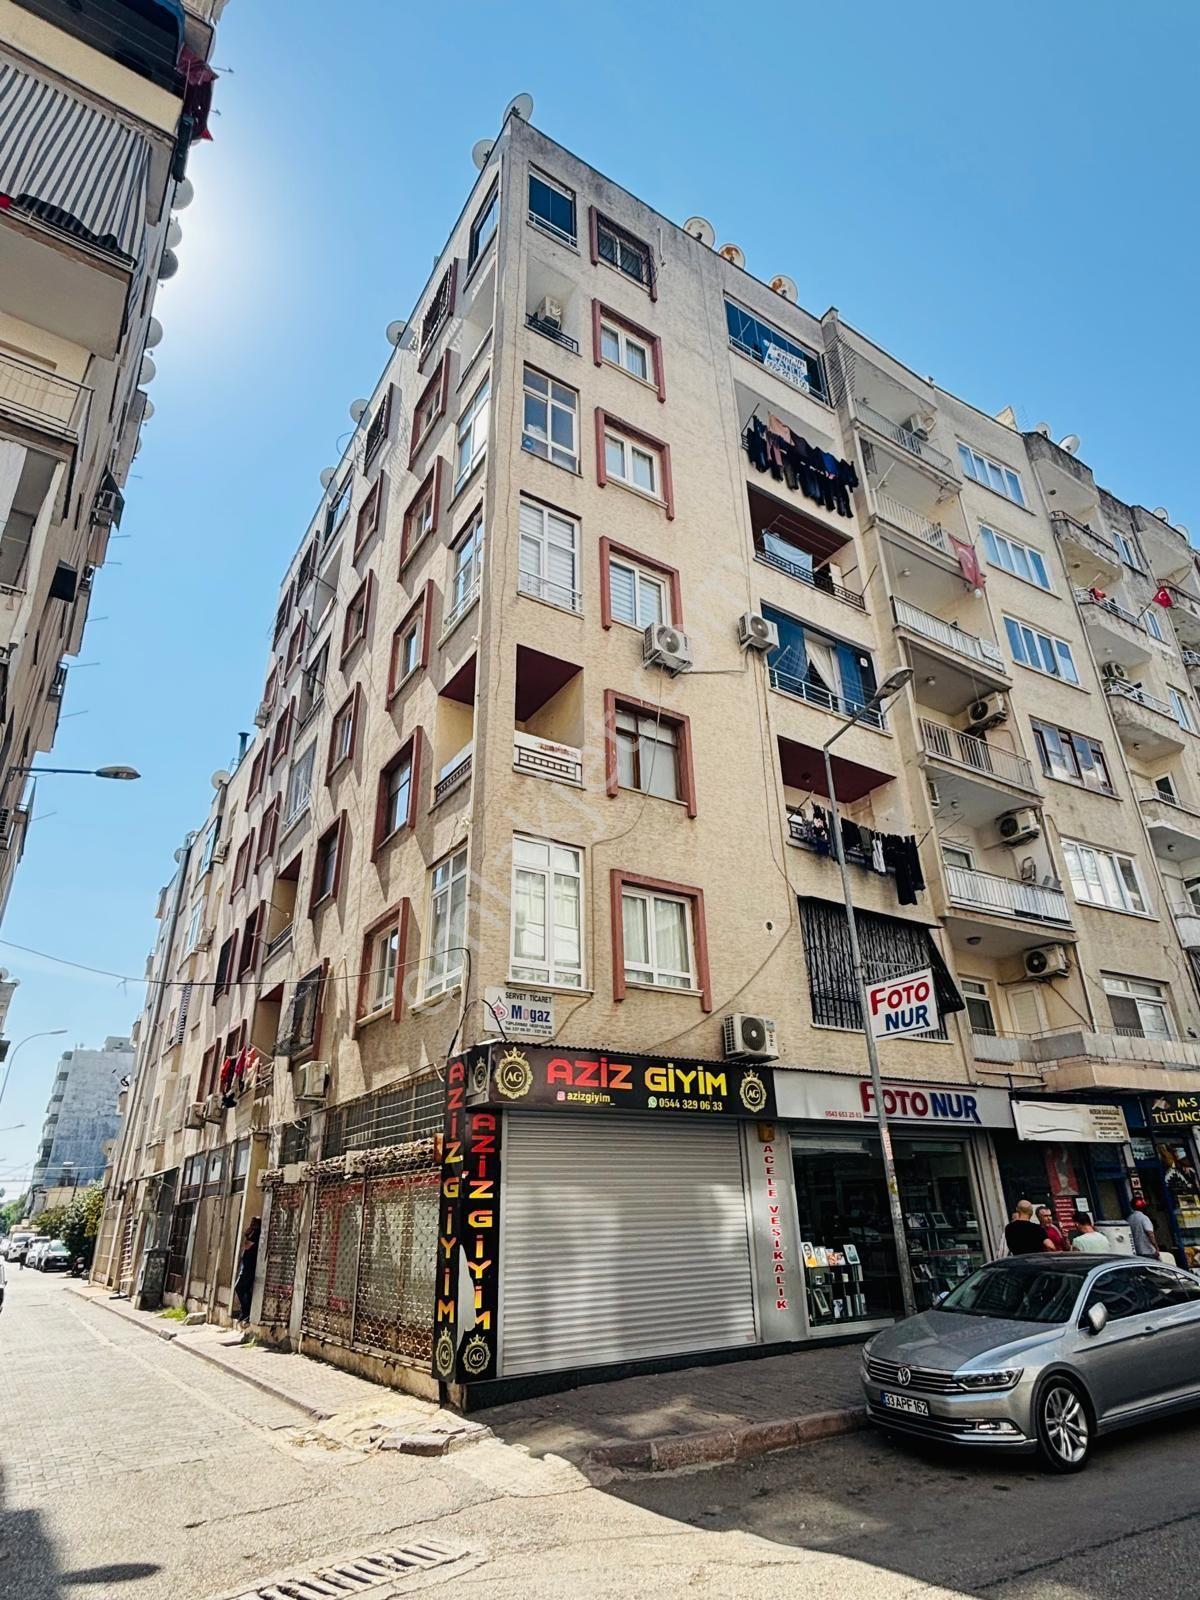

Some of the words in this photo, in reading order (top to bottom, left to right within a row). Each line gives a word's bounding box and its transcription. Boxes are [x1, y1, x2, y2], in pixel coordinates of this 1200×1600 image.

[505, 991, 527, 1001] SERVET
[870, 981, 930, 1016] FOTO
[511, 1004, 551, 1023] Mogaz
[885, 1004, 931, 1032] NUR
[546, 1056, 633, 1090] AZİZ
[644, 1062, 728, 1097] GİYİM
[659, 1097, 681, 1109] 0544
[682, 1098, 698, 1110] 329
[699, 1100, 711, 1111] 06
[712, 1101, 723, 1112] 33
[859, 1080, 929, 1117] FOTO
[929, 1091, 982, 1125] NUR
[1177, 1097, 1198, 1108] M-S
[1152, 1109, 1200, 1124] TÜTÜNC
[468, 1112, 497, 1199] AZİZ
[763, 1145, 777, 1197] ACELE
[885, 1394, 895, 1407] 33
[896, 1397, 912, 1410] APF
[913, 1400, 928, 1415] 162
